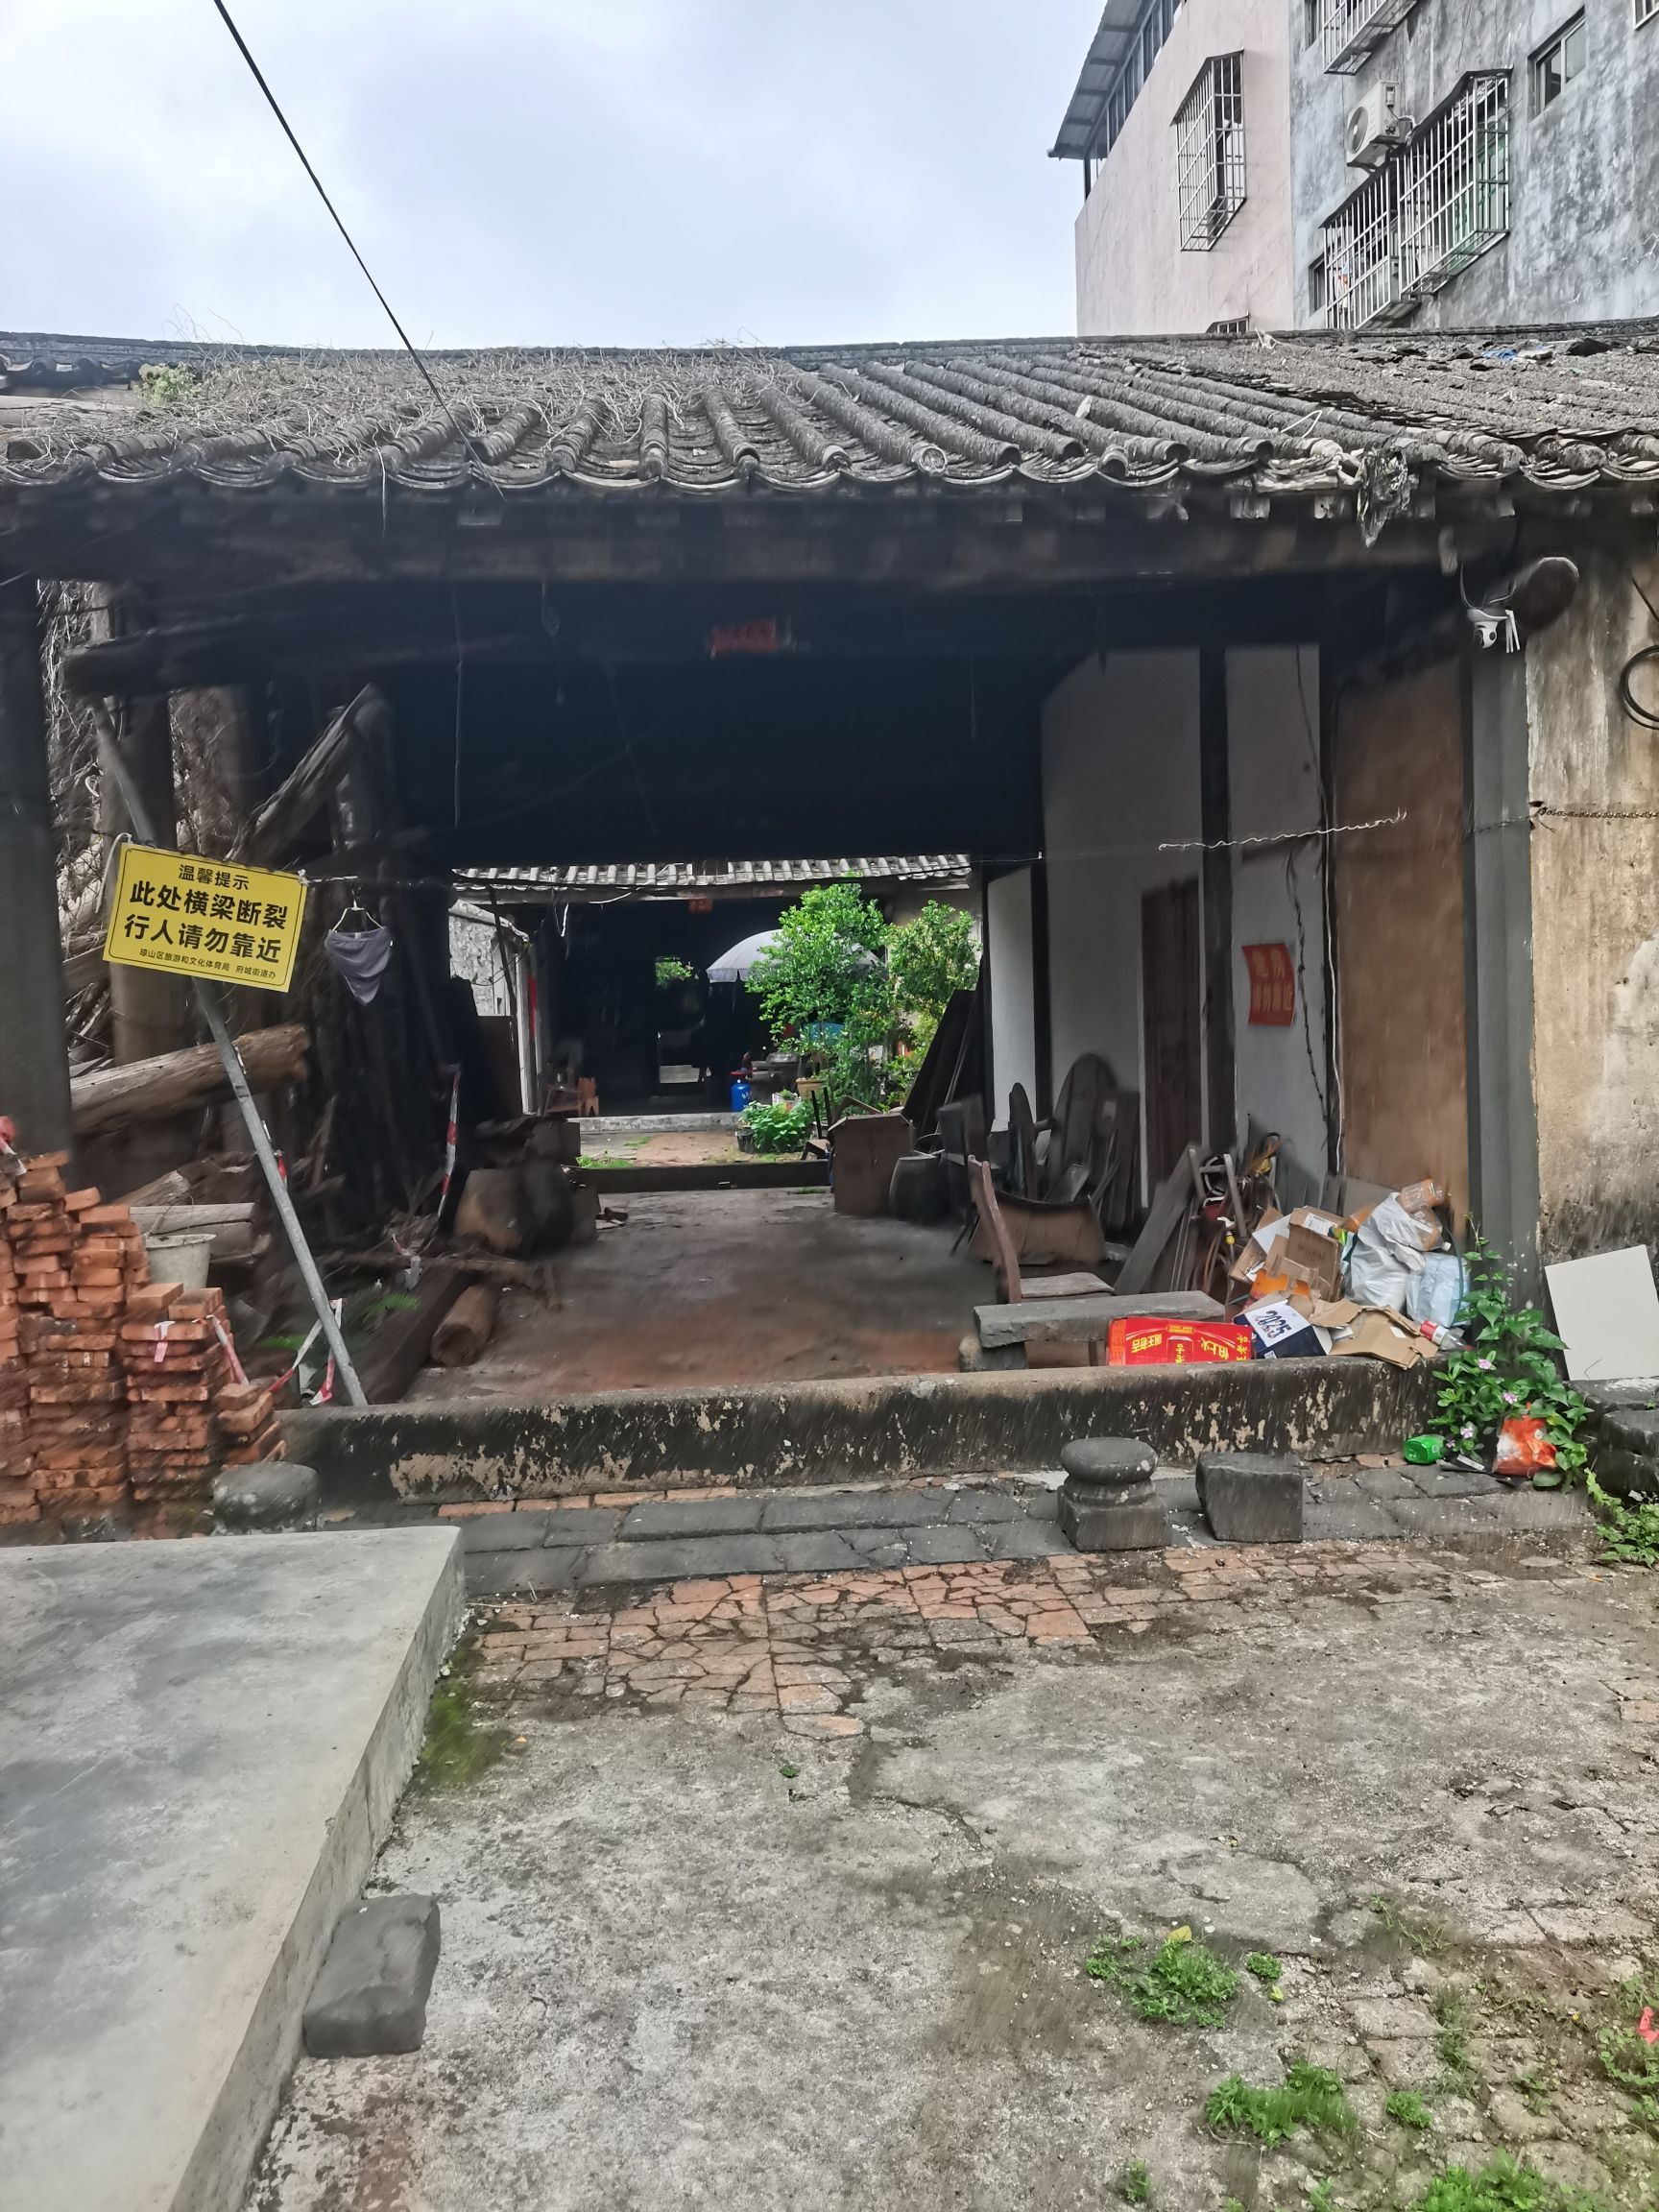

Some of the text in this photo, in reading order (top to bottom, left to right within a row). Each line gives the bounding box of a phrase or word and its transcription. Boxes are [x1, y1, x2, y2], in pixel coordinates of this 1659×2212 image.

[179, 863, 250, 891] 温馨提示
[130, 880, 288, 930] 此处横梁断裂
[124, 913, 282, 964] 行人请勿靠近
[1256, 1310, 1292, 1338] 2025
[1200, 1336, 1230, 1360] 怕上火
